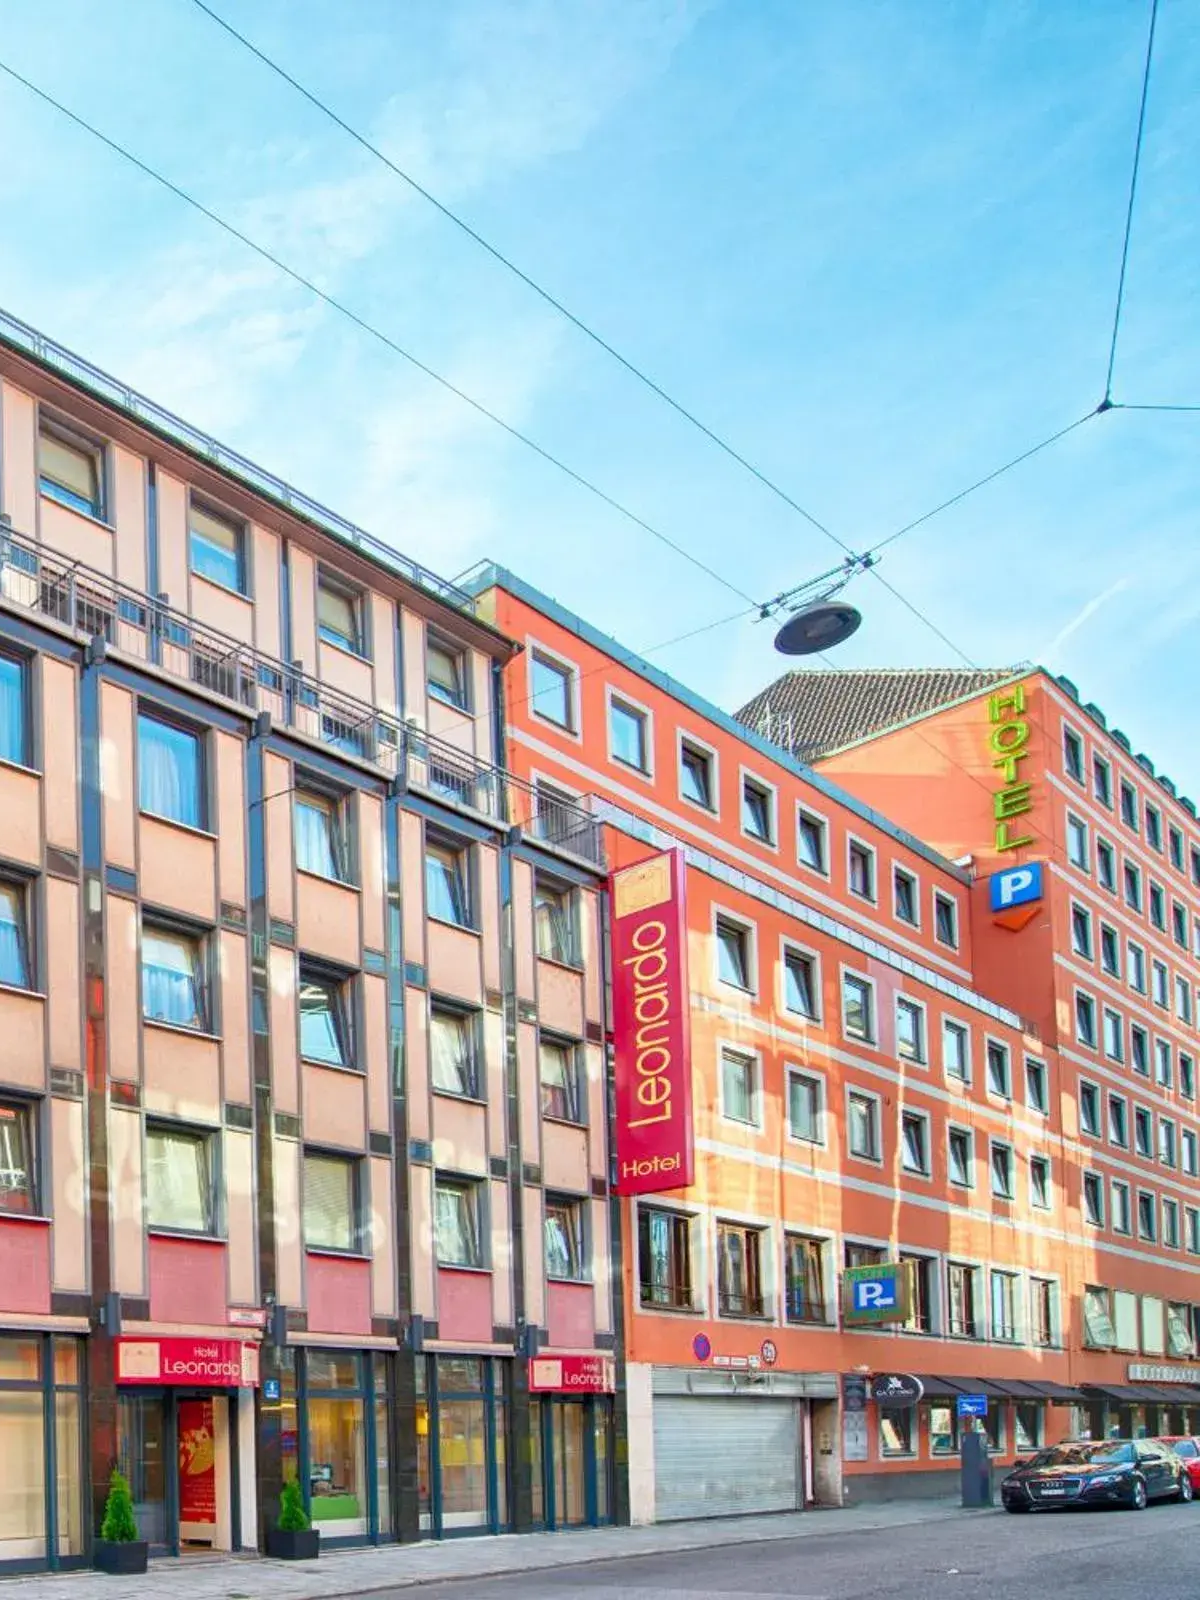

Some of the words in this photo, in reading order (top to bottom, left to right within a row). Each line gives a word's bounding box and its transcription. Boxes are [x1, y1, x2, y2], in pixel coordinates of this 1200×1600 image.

[988, 684, 1035, 853] HOTEL
[1000, 869, 1033, 905] P
[622, 919, 673, 1128] Leonardo
[622, 1151, 681, 1178] Hotel
[858, 1282, 884, 1307] P
[193, 1346, 219, 1358] Hotel
[164, 1357, 241, 1377] Leonardo
